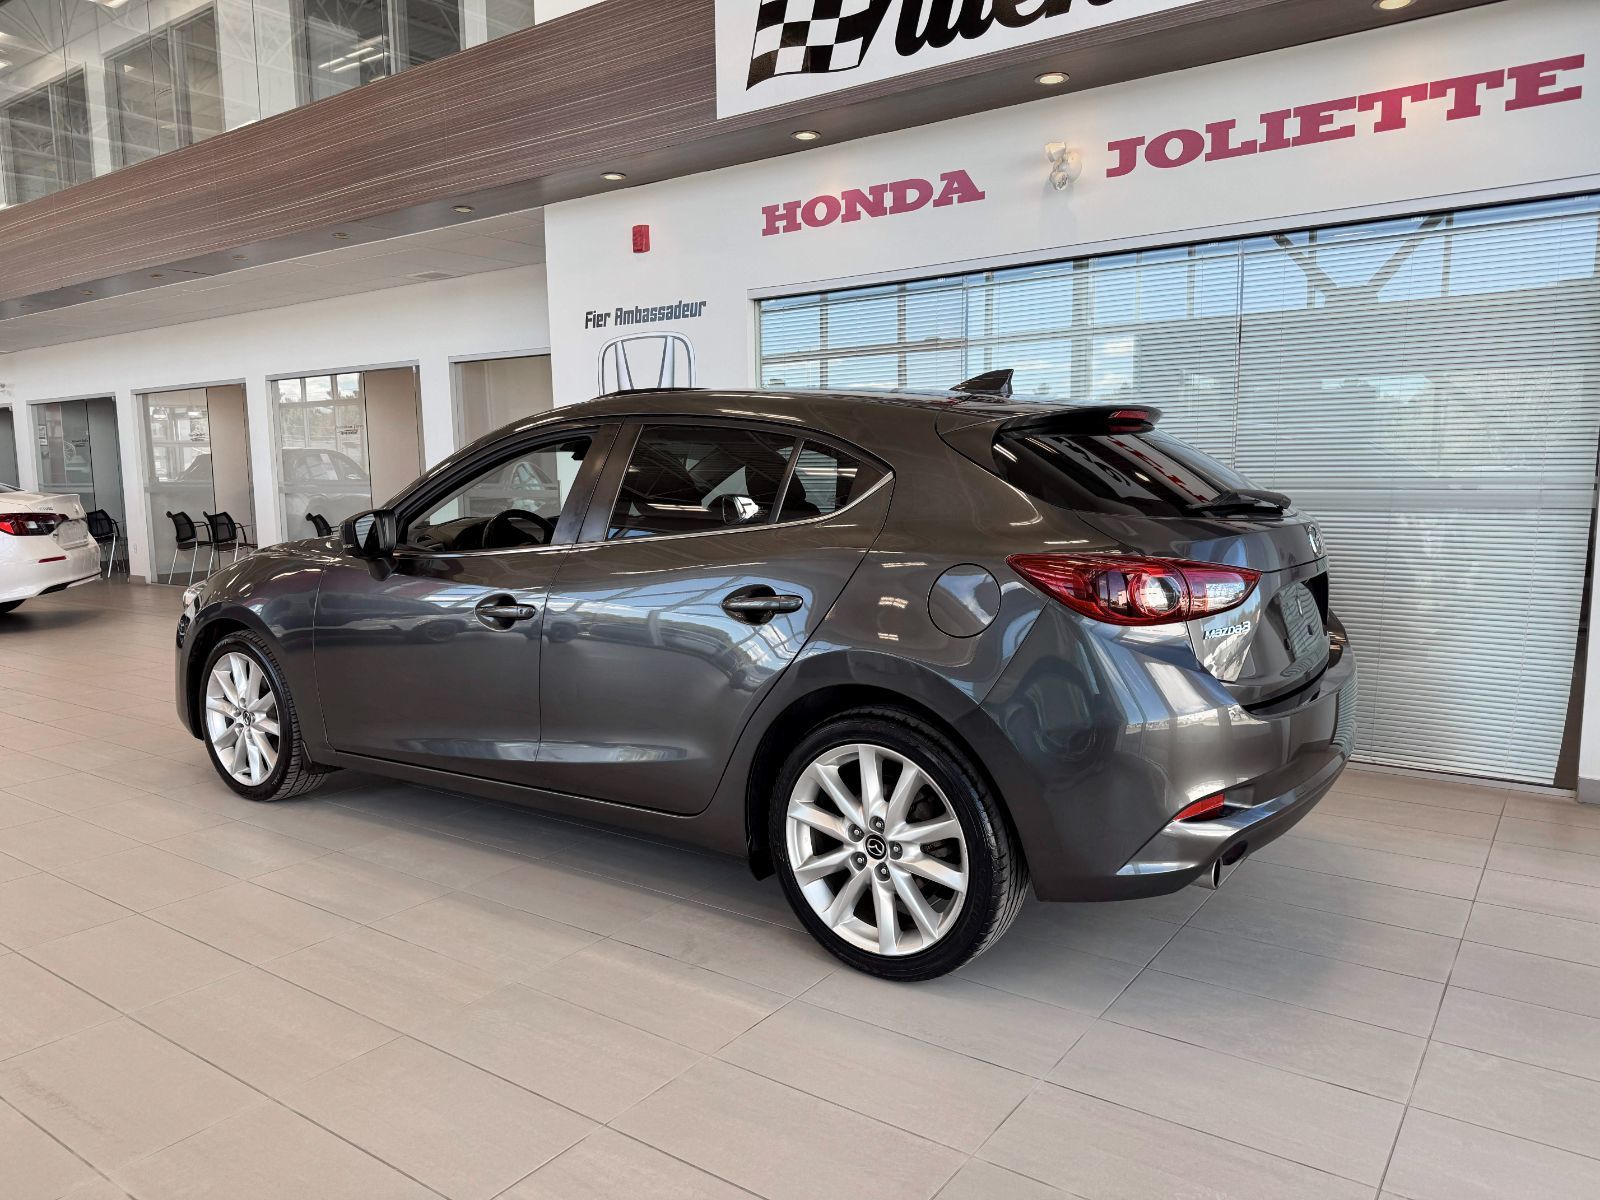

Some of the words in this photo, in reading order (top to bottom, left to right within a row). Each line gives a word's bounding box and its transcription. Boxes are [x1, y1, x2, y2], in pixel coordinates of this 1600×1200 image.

[762, 169, 985, 236] HONDA
[1106, 54, 1585, 178] JOLIETTE
[585, 310, 611, 329] Fier
[614, 300, 707, 326] Ambassadeur
